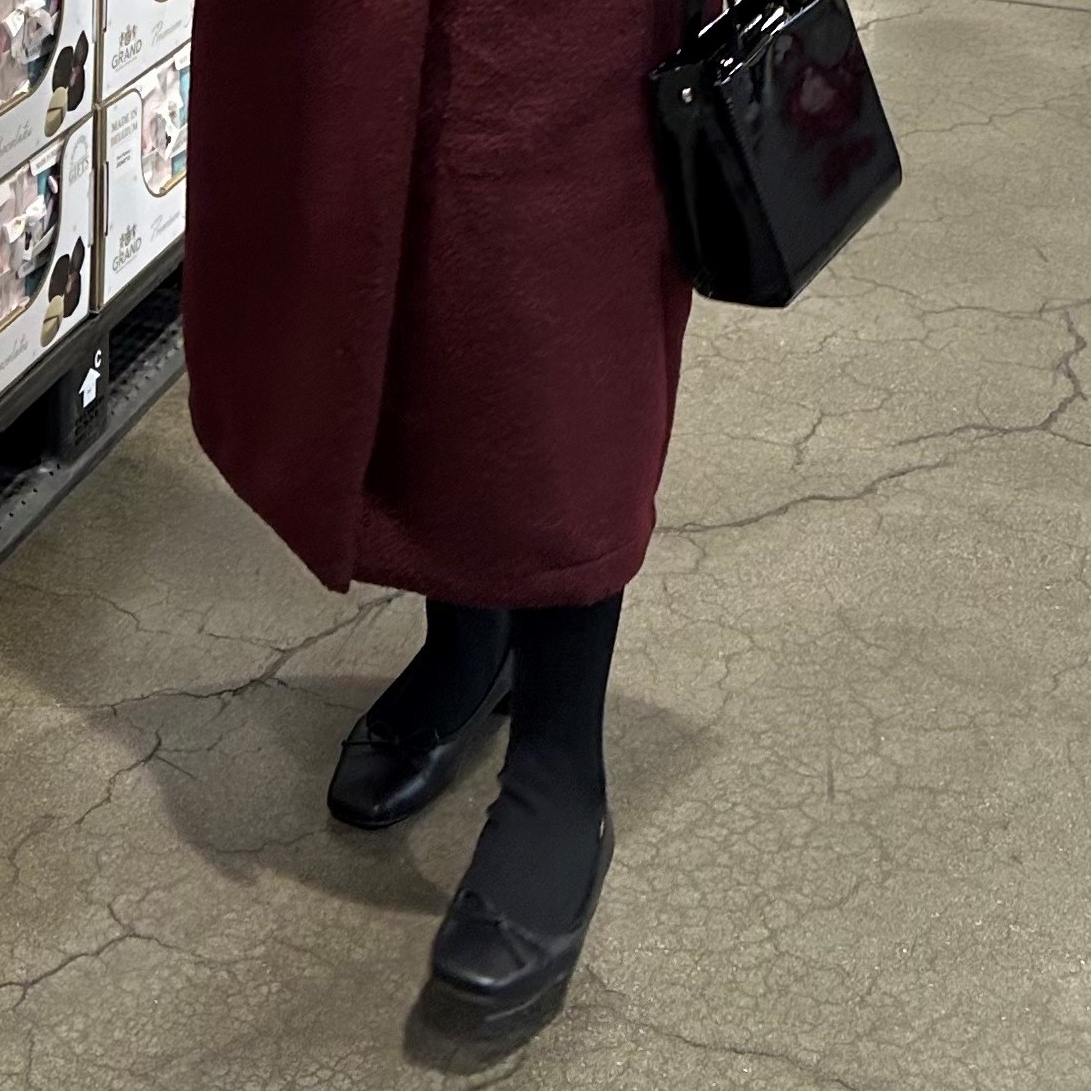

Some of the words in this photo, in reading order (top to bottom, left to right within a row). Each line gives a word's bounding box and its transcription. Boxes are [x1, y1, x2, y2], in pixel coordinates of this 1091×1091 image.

[111, 40, 142, 69] GRAND
[68, 159, 90, 185] GIFTS
[112, 237, 142, 272] GRAND
